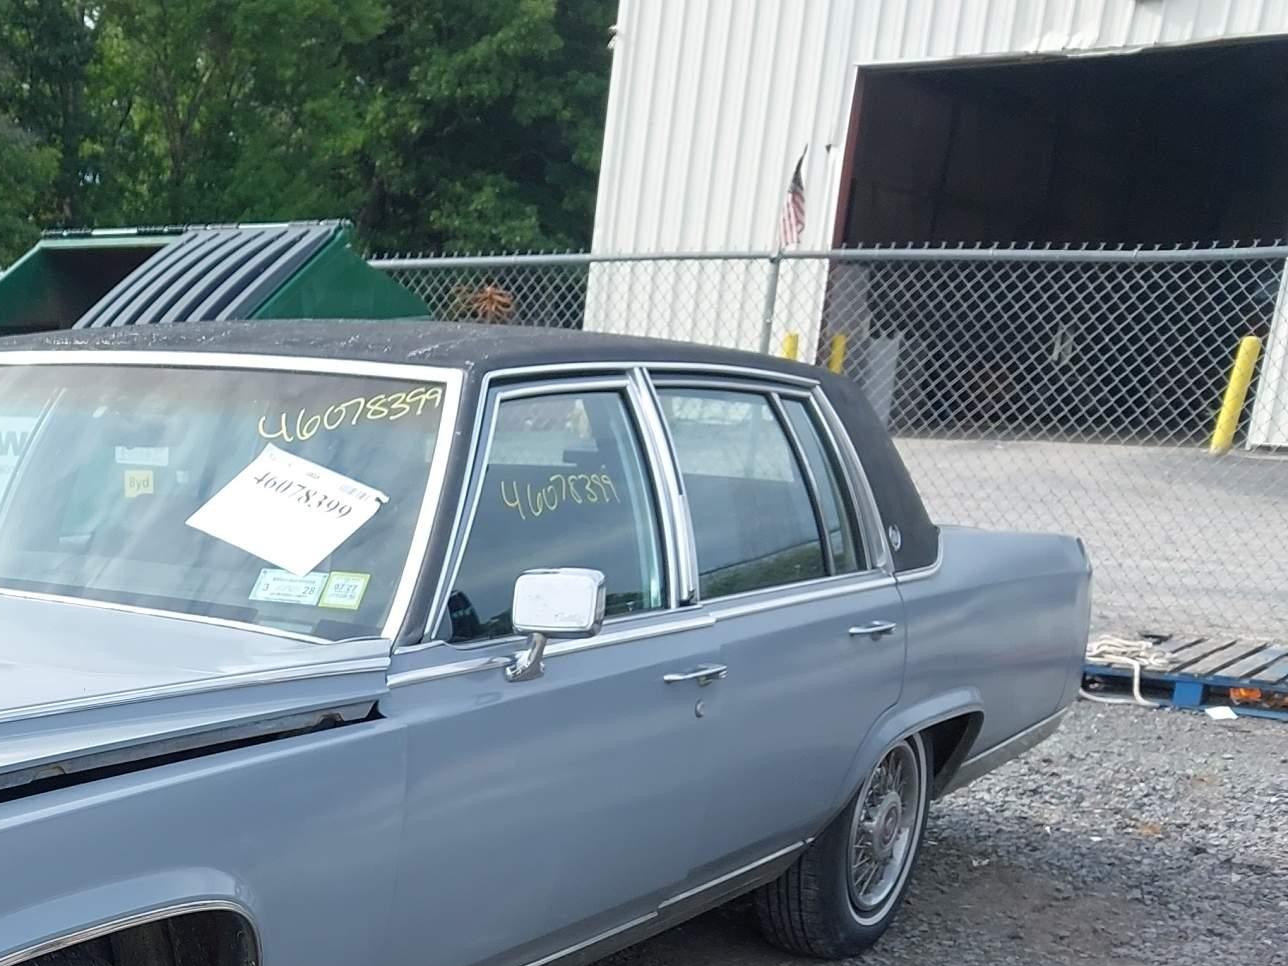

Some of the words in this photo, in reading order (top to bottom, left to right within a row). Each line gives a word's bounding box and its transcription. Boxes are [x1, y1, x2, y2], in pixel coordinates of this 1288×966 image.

[258, 387, 442, 442] 46078399
[253, 471, 353, 519] 46078399
[500, 473, 620, 520] 46078399
